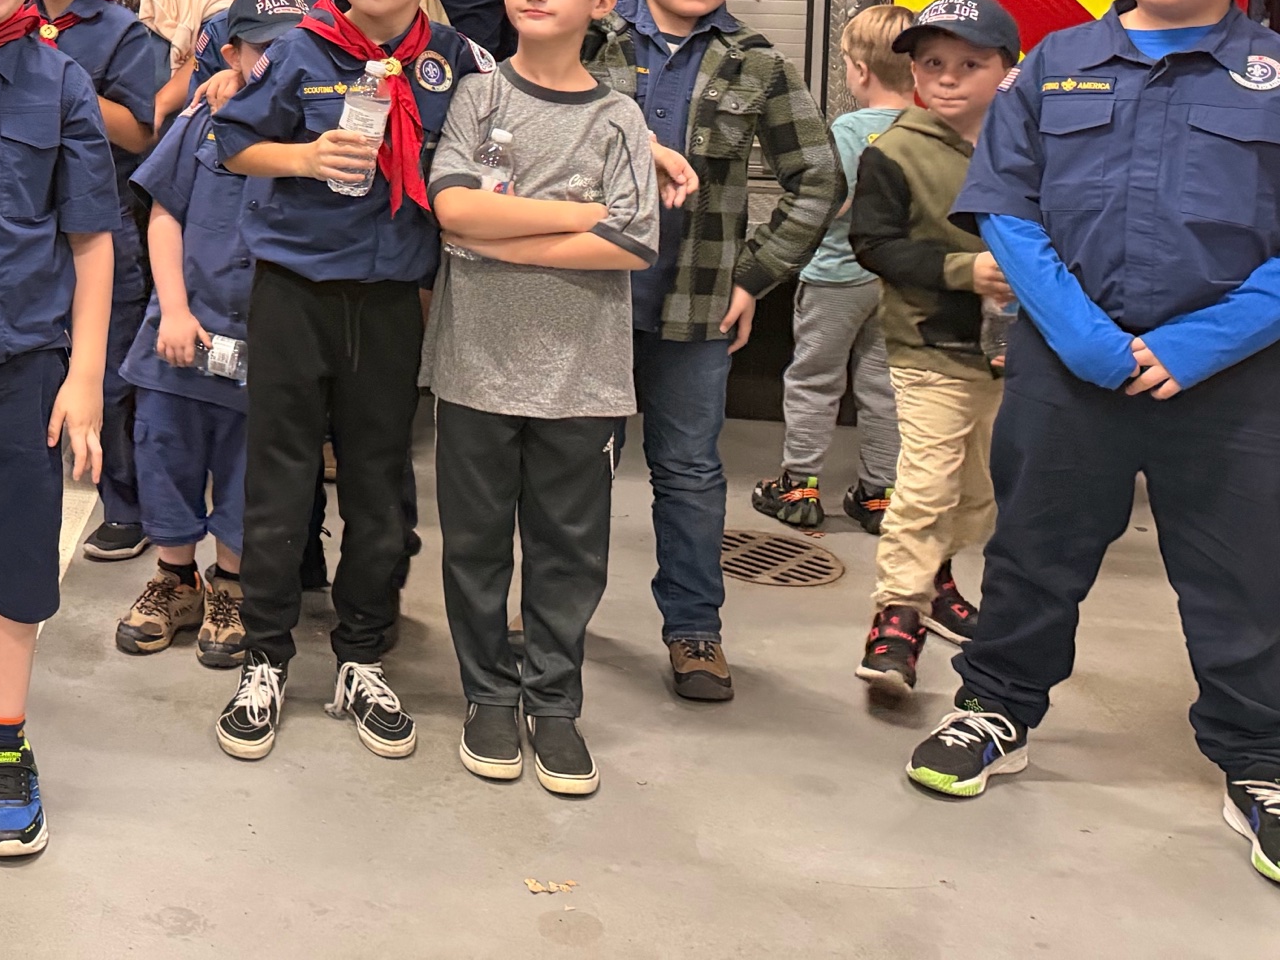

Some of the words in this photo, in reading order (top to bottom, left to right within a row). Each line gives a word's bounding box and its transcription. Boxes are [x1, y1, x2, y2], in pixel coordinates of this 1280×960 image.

[953, 3, 979, 21] 102
[303, 86, 334, 94] SCOUTING
[1077, 81, 1111, 91] AMERICA
